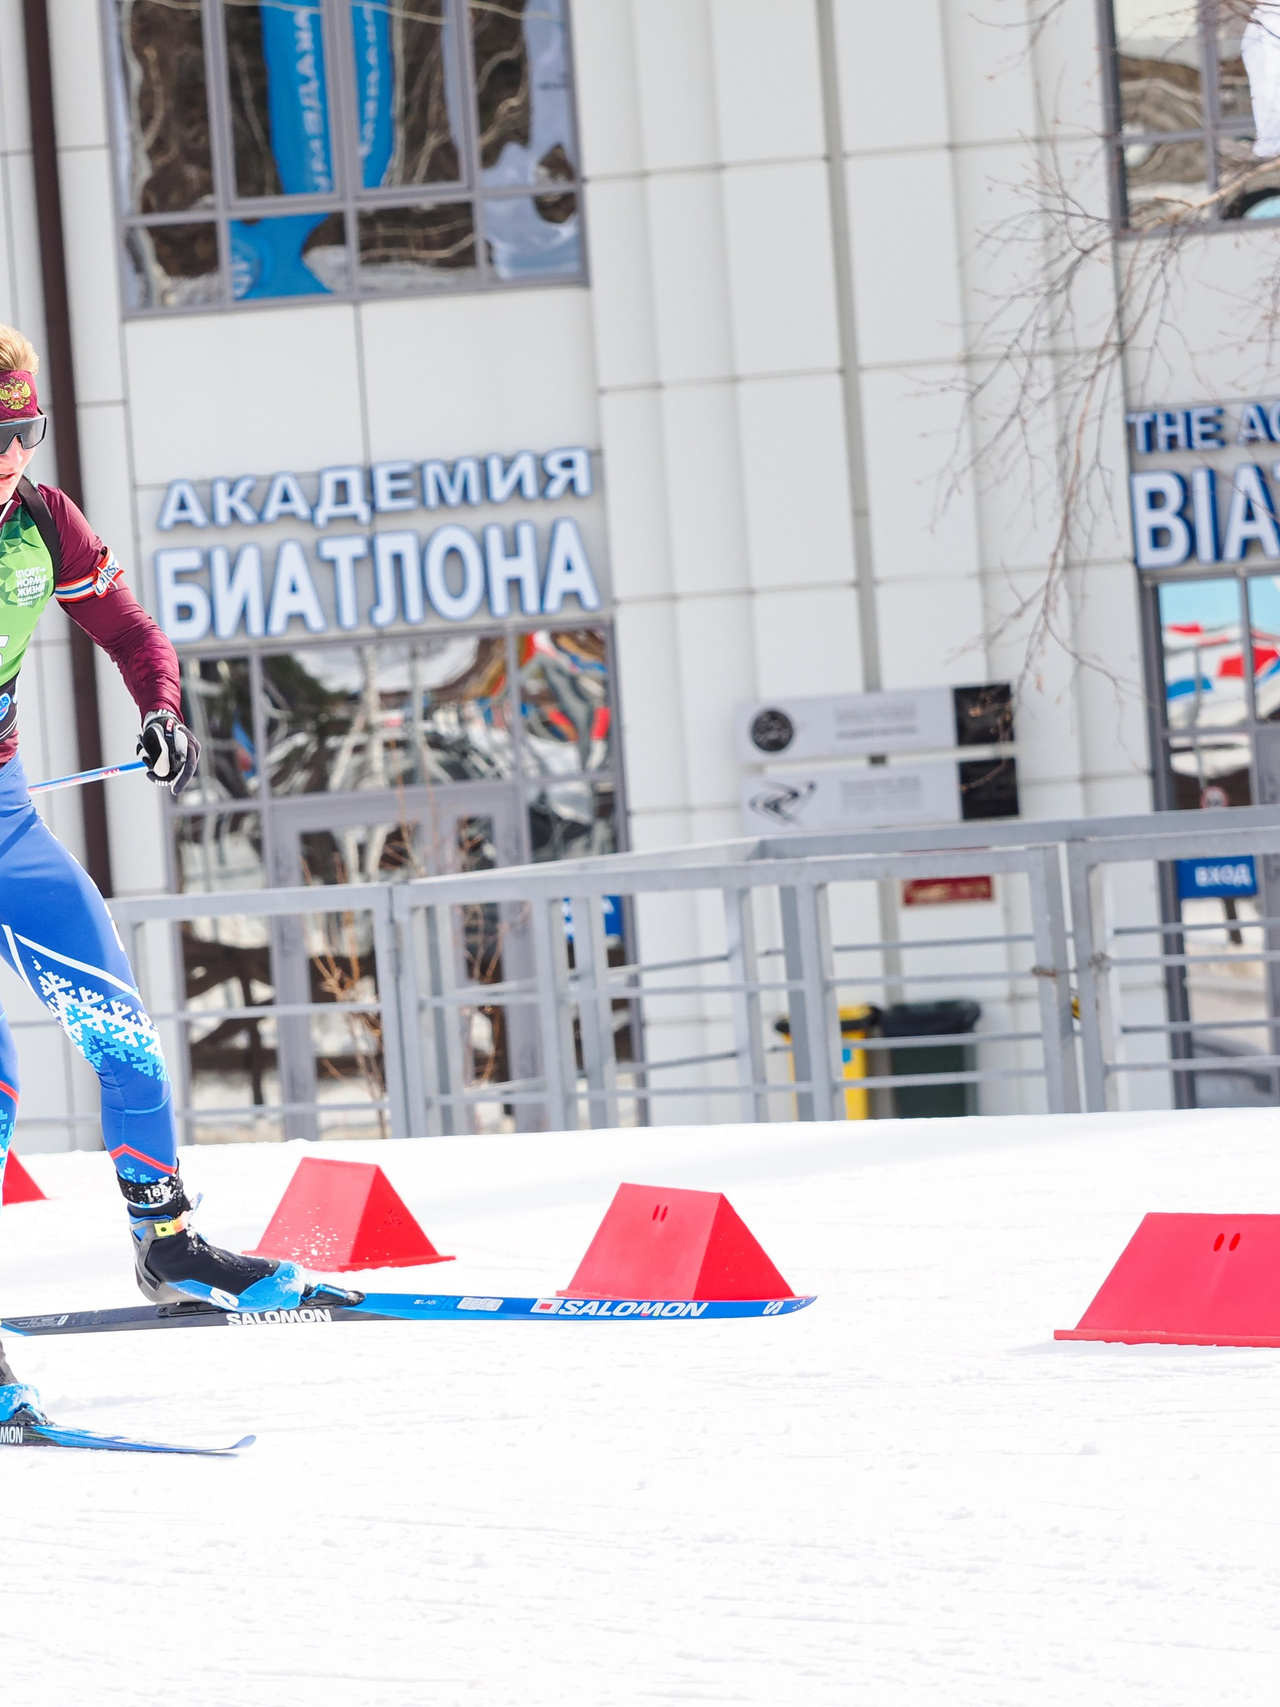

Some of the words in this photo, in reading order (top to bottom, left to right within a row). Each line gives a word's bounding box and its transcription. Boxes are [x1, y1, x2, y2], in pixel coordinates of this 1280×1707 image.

[1125, 407, 1226, 455] THE
[156, 446, 593, 531] АКАДЕМИЯ
[1130, 461, 1280, 569] BIA
[155, 518, 602, 645] БИАТЛОНА
[1195, 863, 1252, 887] ВХОД
[226, 1308, 332, 1326] SALOMON
[557, 1300, 709, 1317] SALOMON
